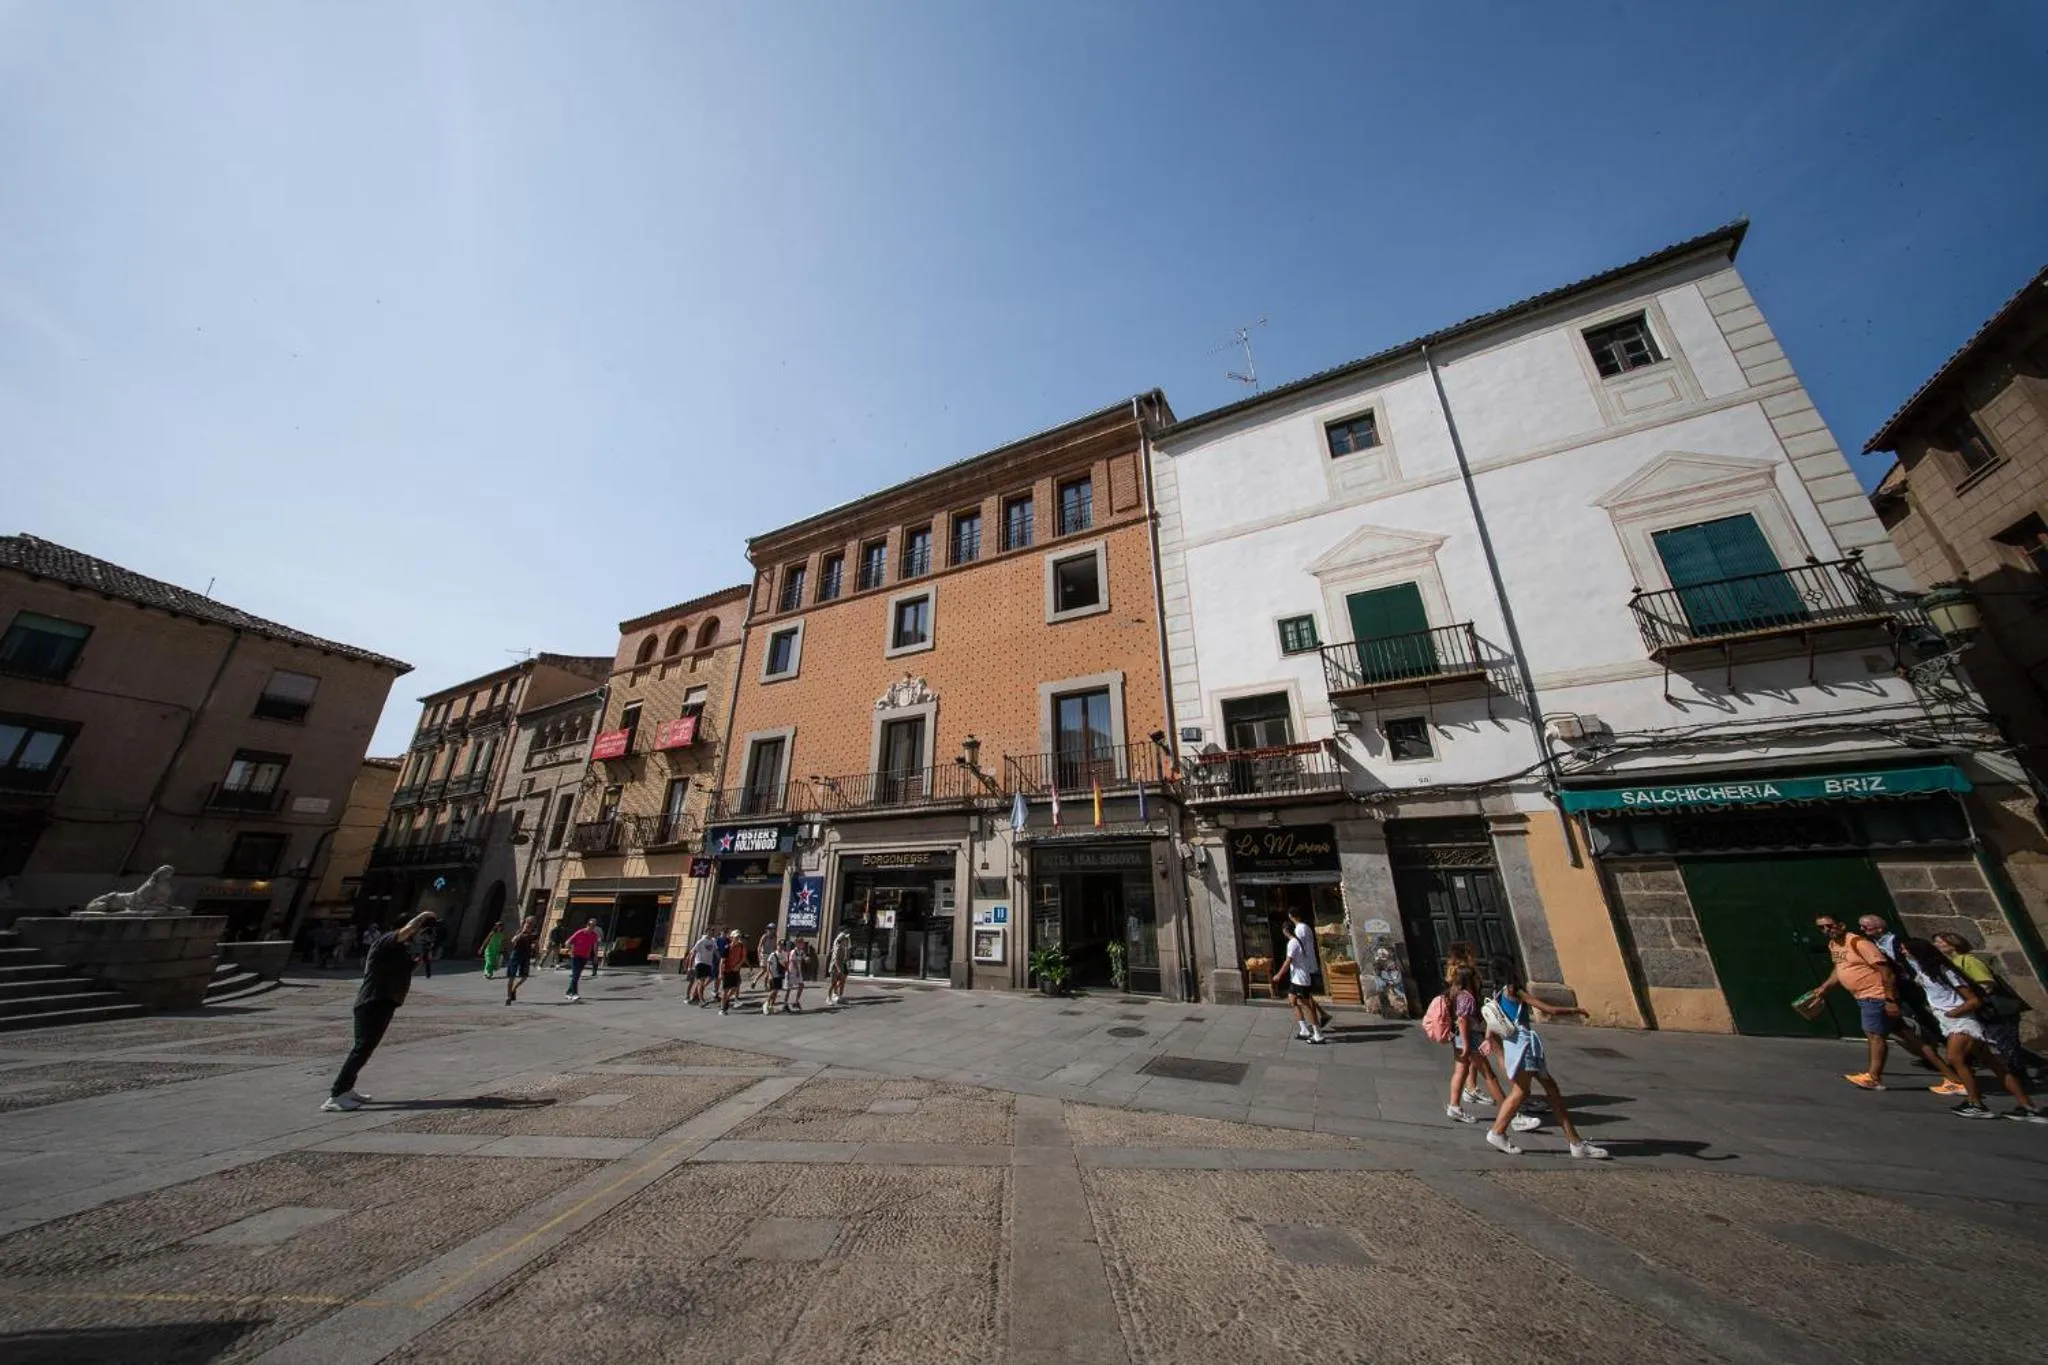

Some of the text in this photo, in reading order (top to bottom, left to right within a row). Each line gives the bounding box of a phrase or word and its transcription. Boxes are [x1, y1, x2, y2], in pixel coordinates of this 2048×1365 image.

[1621, 776, 1887, 805] SALCHICHERIA BRIZ
[734, 839, 776, 852] HOLLYWOOD
[862, 853, 930, 865] BORGONESSE
[1100, 852, 1142, 865] SEGOVIA
